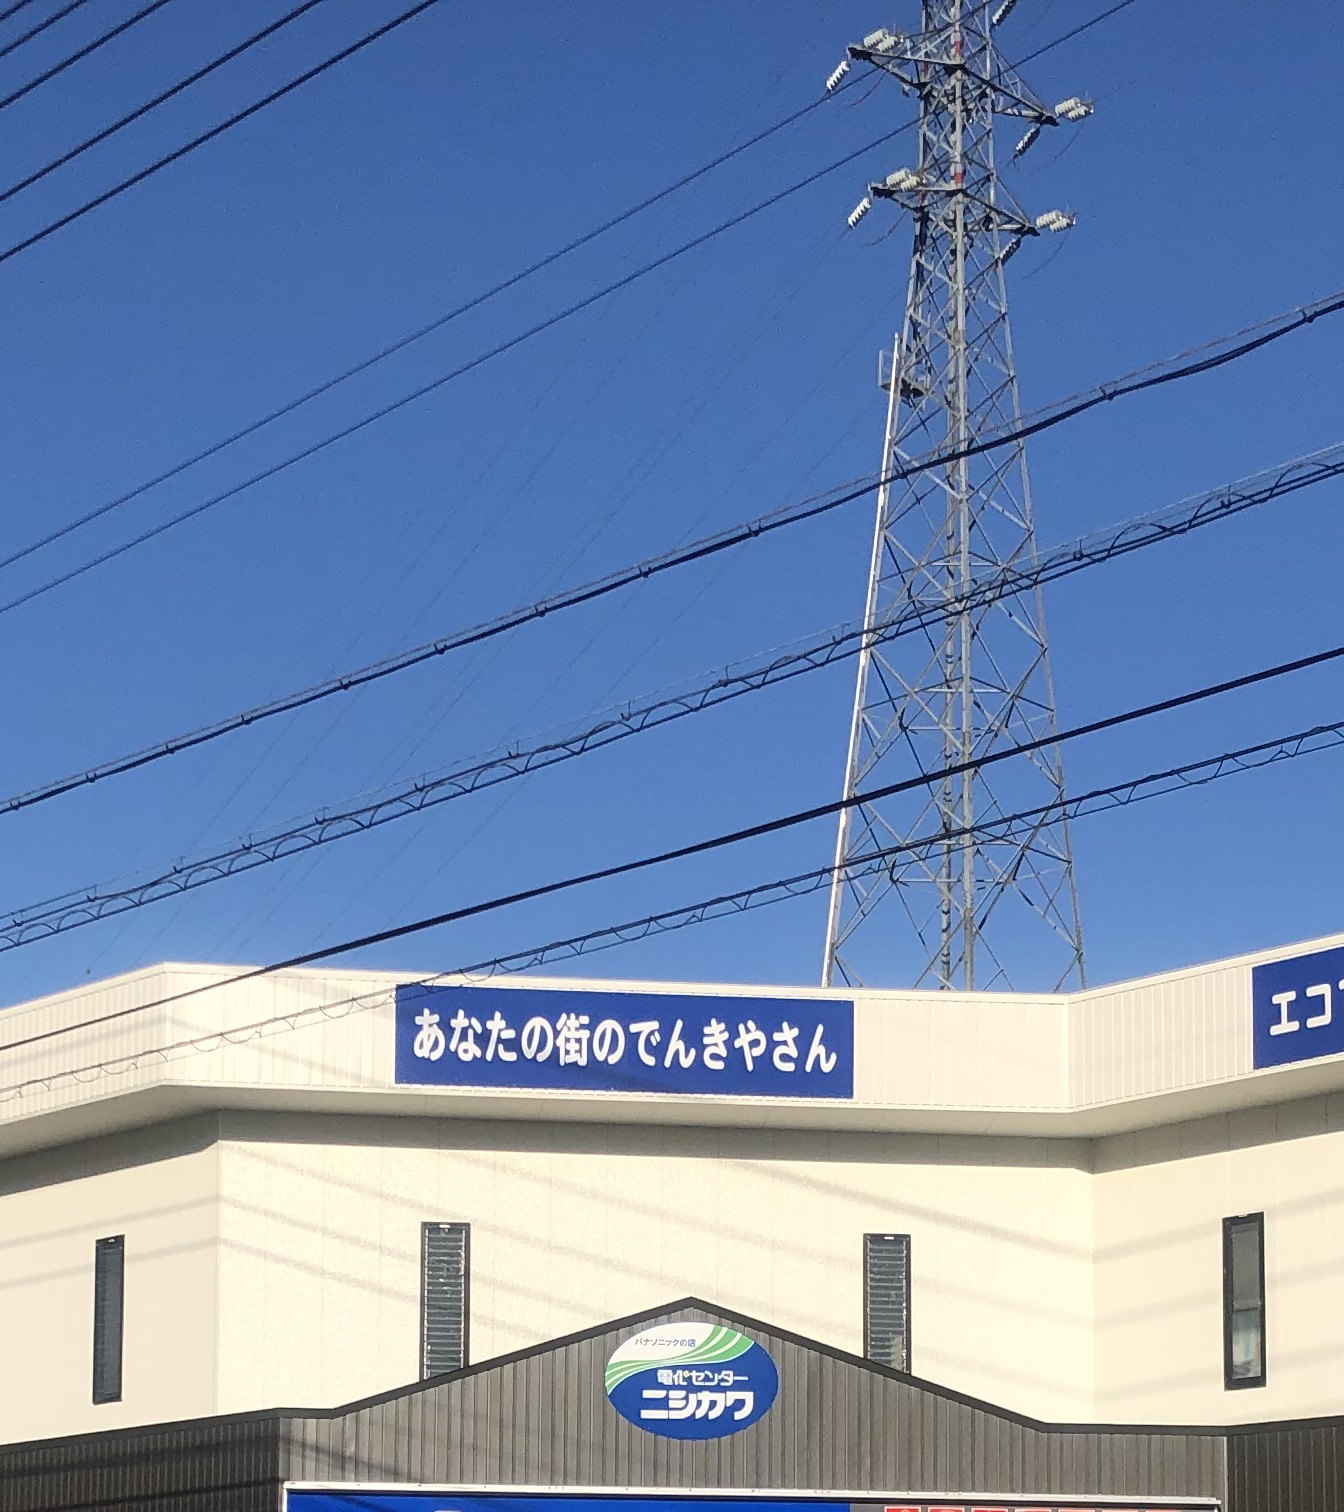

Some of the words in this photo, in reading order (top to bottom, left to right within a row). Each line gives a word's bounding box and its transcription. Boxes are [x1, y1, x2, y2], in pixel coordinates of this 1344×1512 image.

[413, 1008, 838, 1074] あなたの街のでんきやさん
[634, 1338, 697, 1348] パナソニックの店
[657, 1369, 749, 1387] 電化センター
[640, 1389, 754, 1421] ニシカワ
